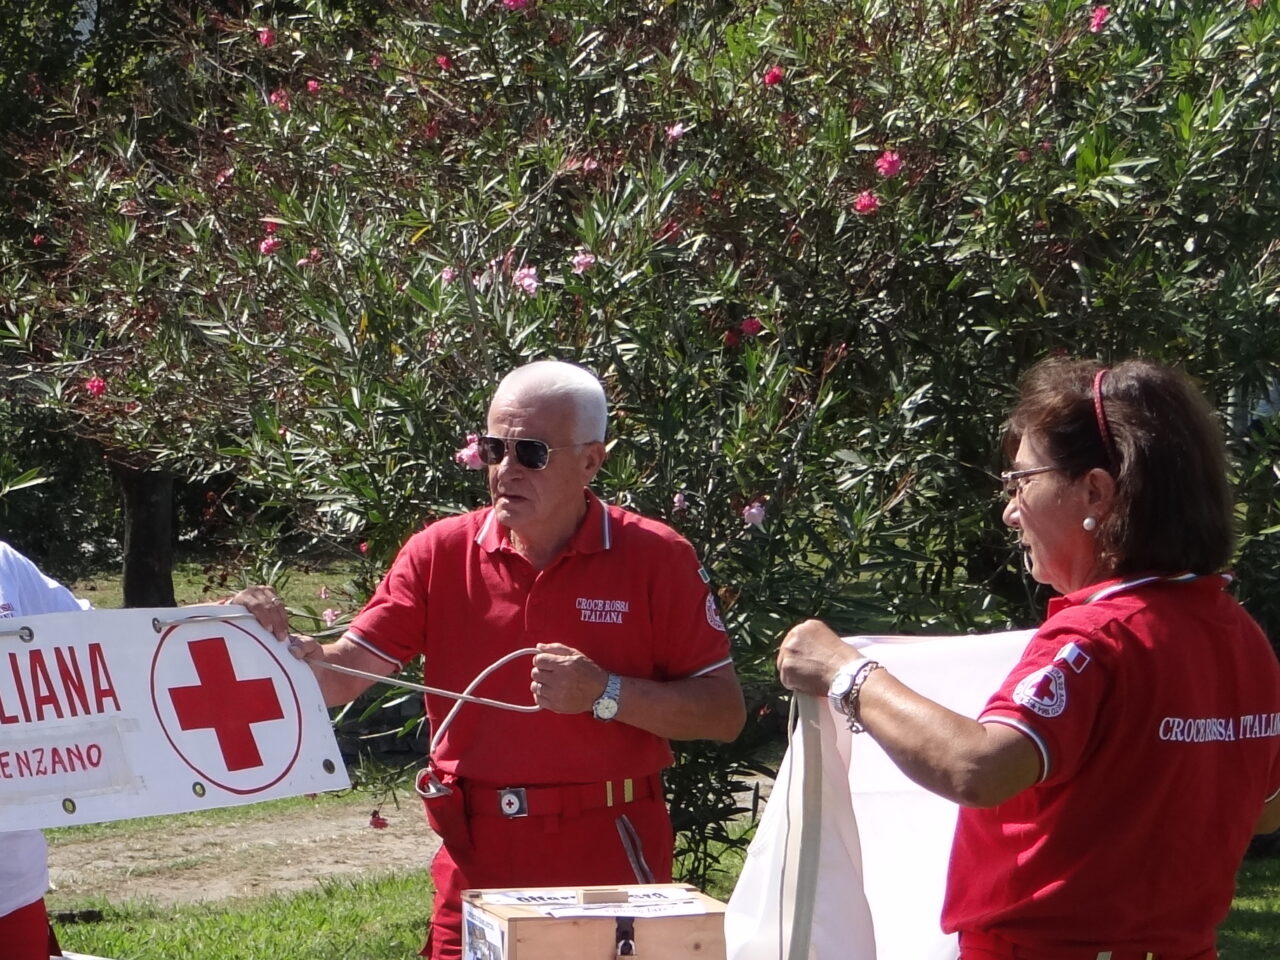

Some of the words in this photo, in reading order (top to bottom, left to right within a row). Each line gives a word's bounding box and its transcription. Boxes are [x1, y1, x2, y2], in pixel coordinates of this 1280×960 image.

[575, 598, 604, 612] CROCE
[604, 599, 630, 613] ROSSA
[580, 610, 623, 624] ITALIANA
[1159, 716, 1205, 743] CROCE
